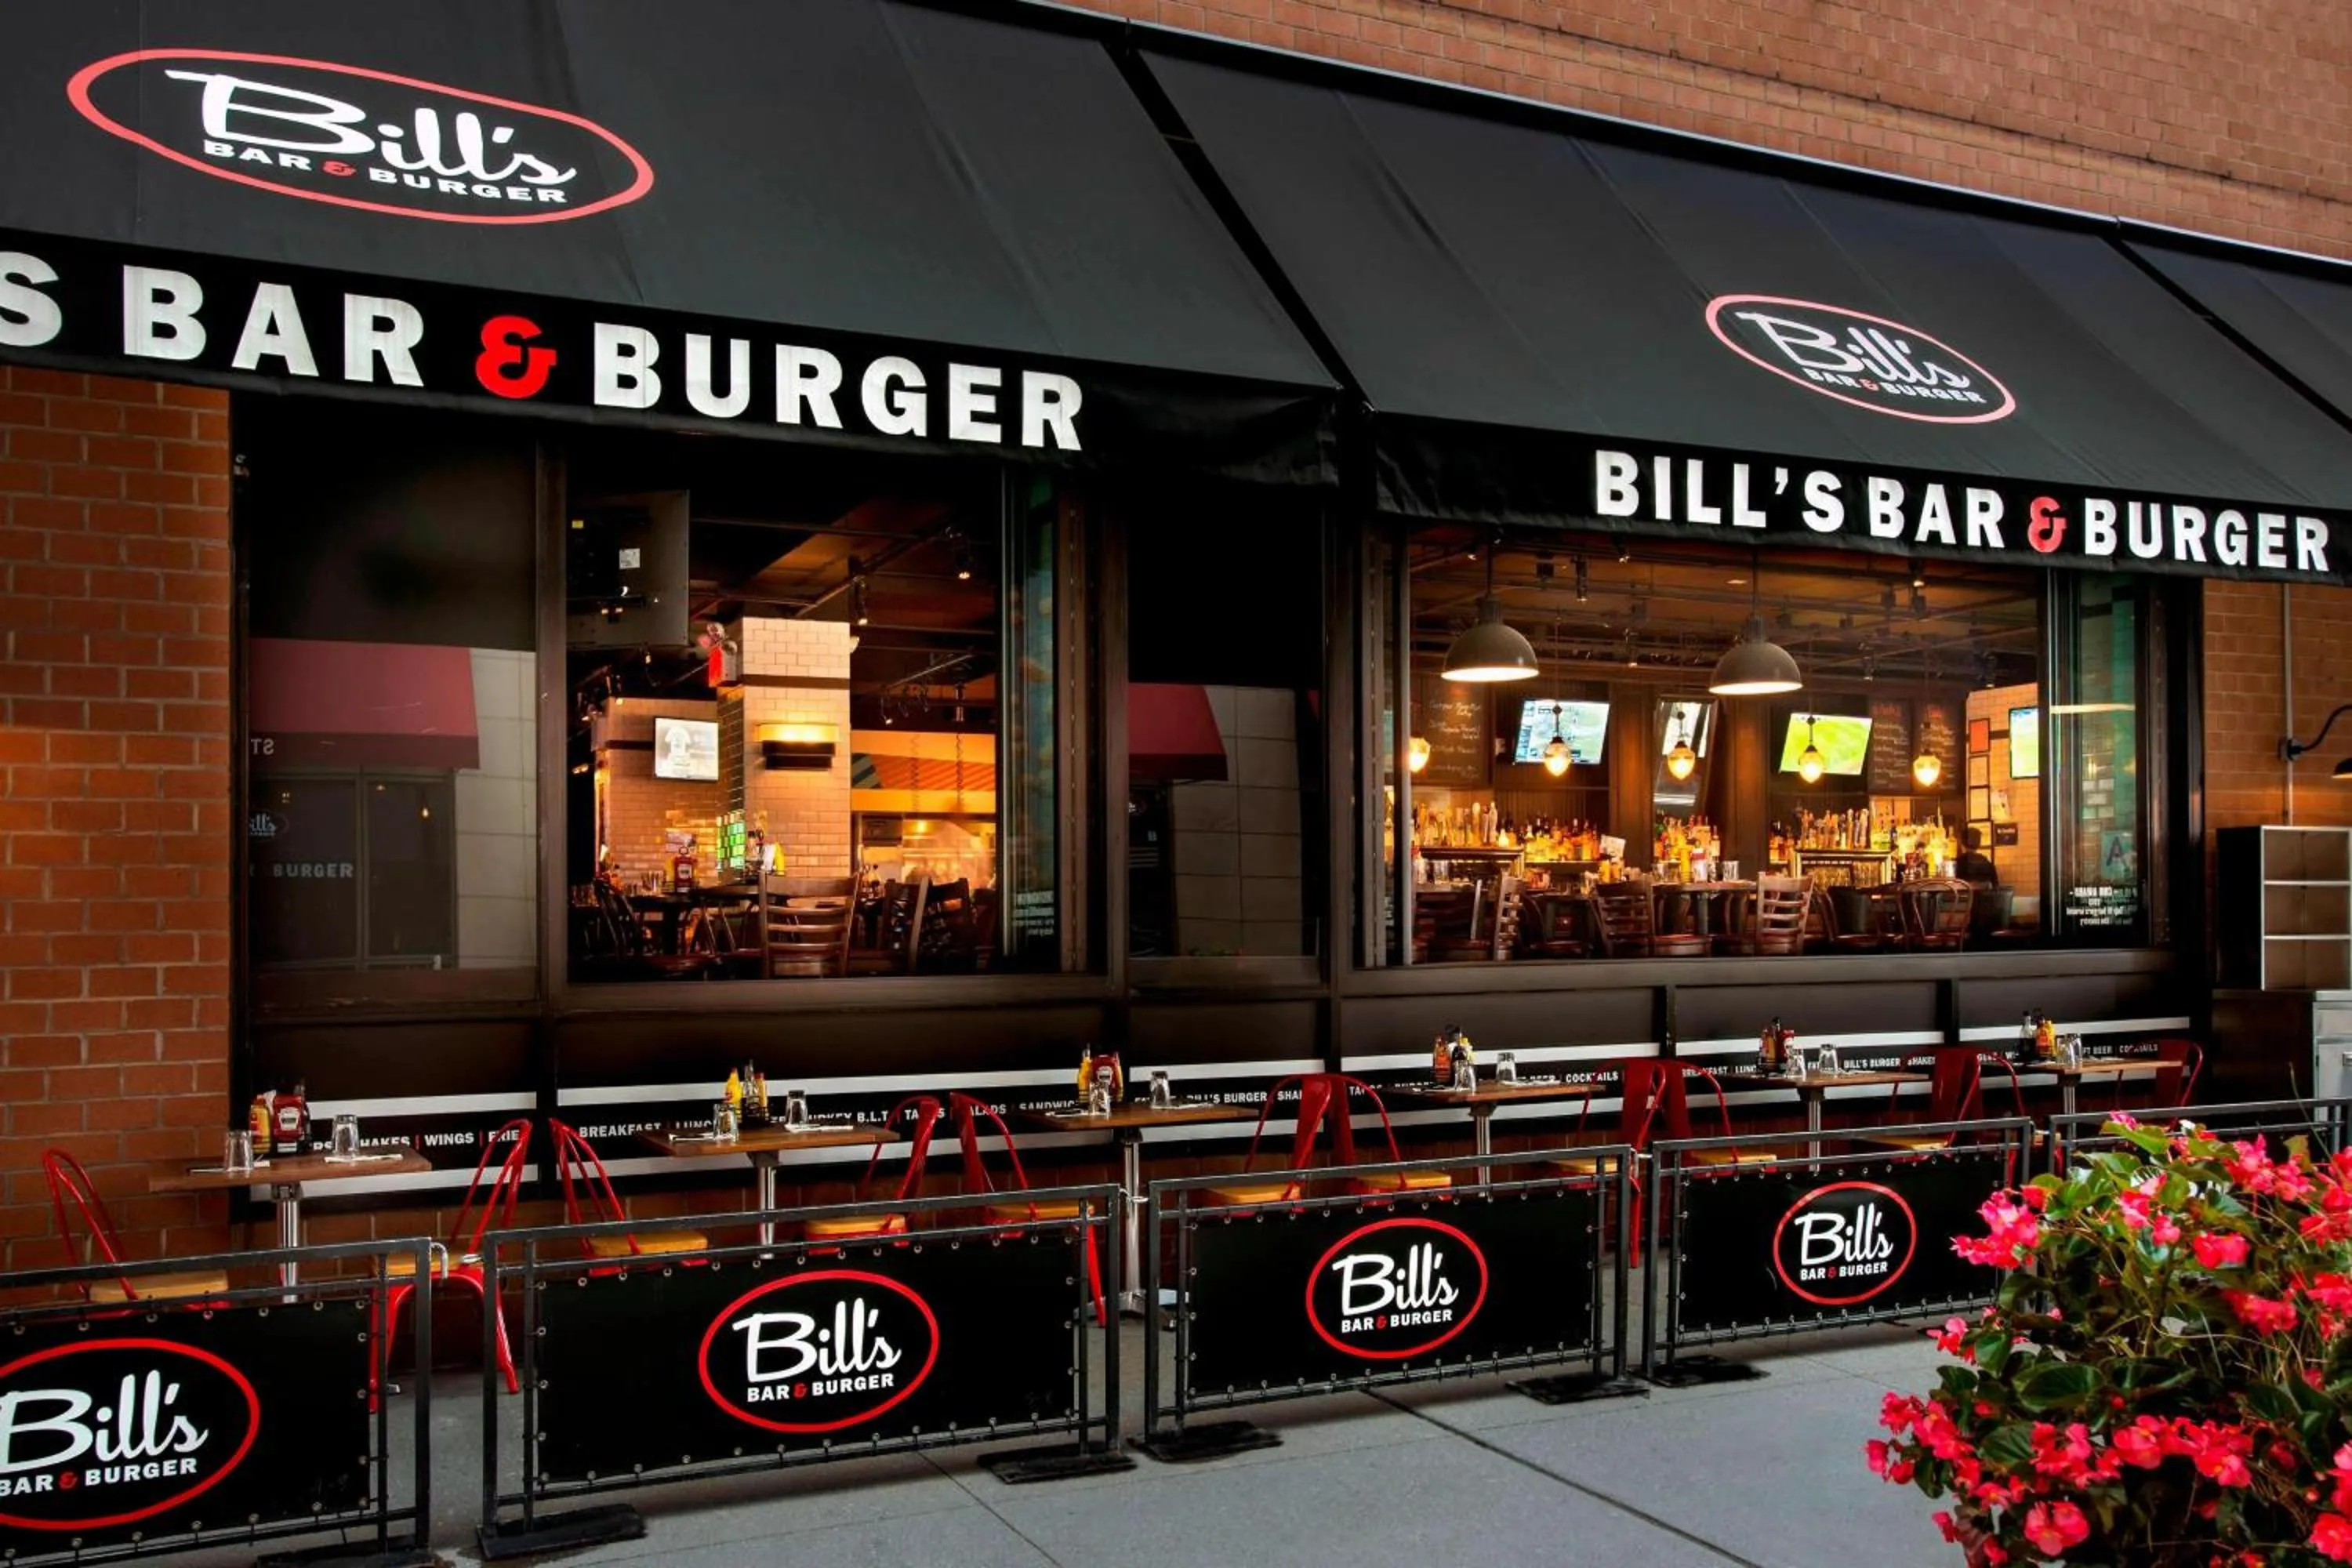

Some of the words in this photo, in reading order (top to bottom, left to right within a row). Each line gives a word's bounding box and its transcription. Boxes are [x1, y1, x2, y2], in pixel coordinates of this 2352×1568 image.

[165, 69, 578, 185] Bill's
[204, 139, 311, 171] BAR
[322, 159, 356, 177] &
[368, 167, 568, 203] BURGER
[123, 264, 424, 387] BAR
[475, 315, 557, 399] &
[593, 321, 1082, 451] BURGER
[1734, 311, 1971, 387] Bill's
[1802, 367, 1862, 388] BAR
[1858, 378, 1880, 392] &
[1878, 381, 1987, 404] BURGER
[1595, 449, 1845, 533] BILL'S
[1867, 476, 2005, 548] BAR
[2027, 496, 2067, 554] &
[2085, 497, 2329, 572] BURGER
[274, 862, 354, 878] BURGER
[1224, 1091, 1268, 1103] BURGER
[1566, 1071, 1619, 1083] COCKAILS
[359, 1136, 410, 1147] HAKES
[424, 1131, 475, 1146] WINGS
[1794, 1202, 1894, 1266] Bill's
[1331, 1242, 1459, 1316] Bill's
[1800, 1266, 1826, 1281] BAR
[1838, 1261, 1889, 1278] BURGER
[732, 1298, 902, 1383] Bill's
[1341, 1317, 1374, 1333] BAR
[1390, 1308, 1453, 1327] BURGER
[747, 1385, 790, 1402] BAR
[811, 1373, 895, 1396] BURGER
[0, 1369, 209, 1474] Bill's
[0, 1474, 54, 1497] BAR
[84, 1457, 197, 1486] BURGER
